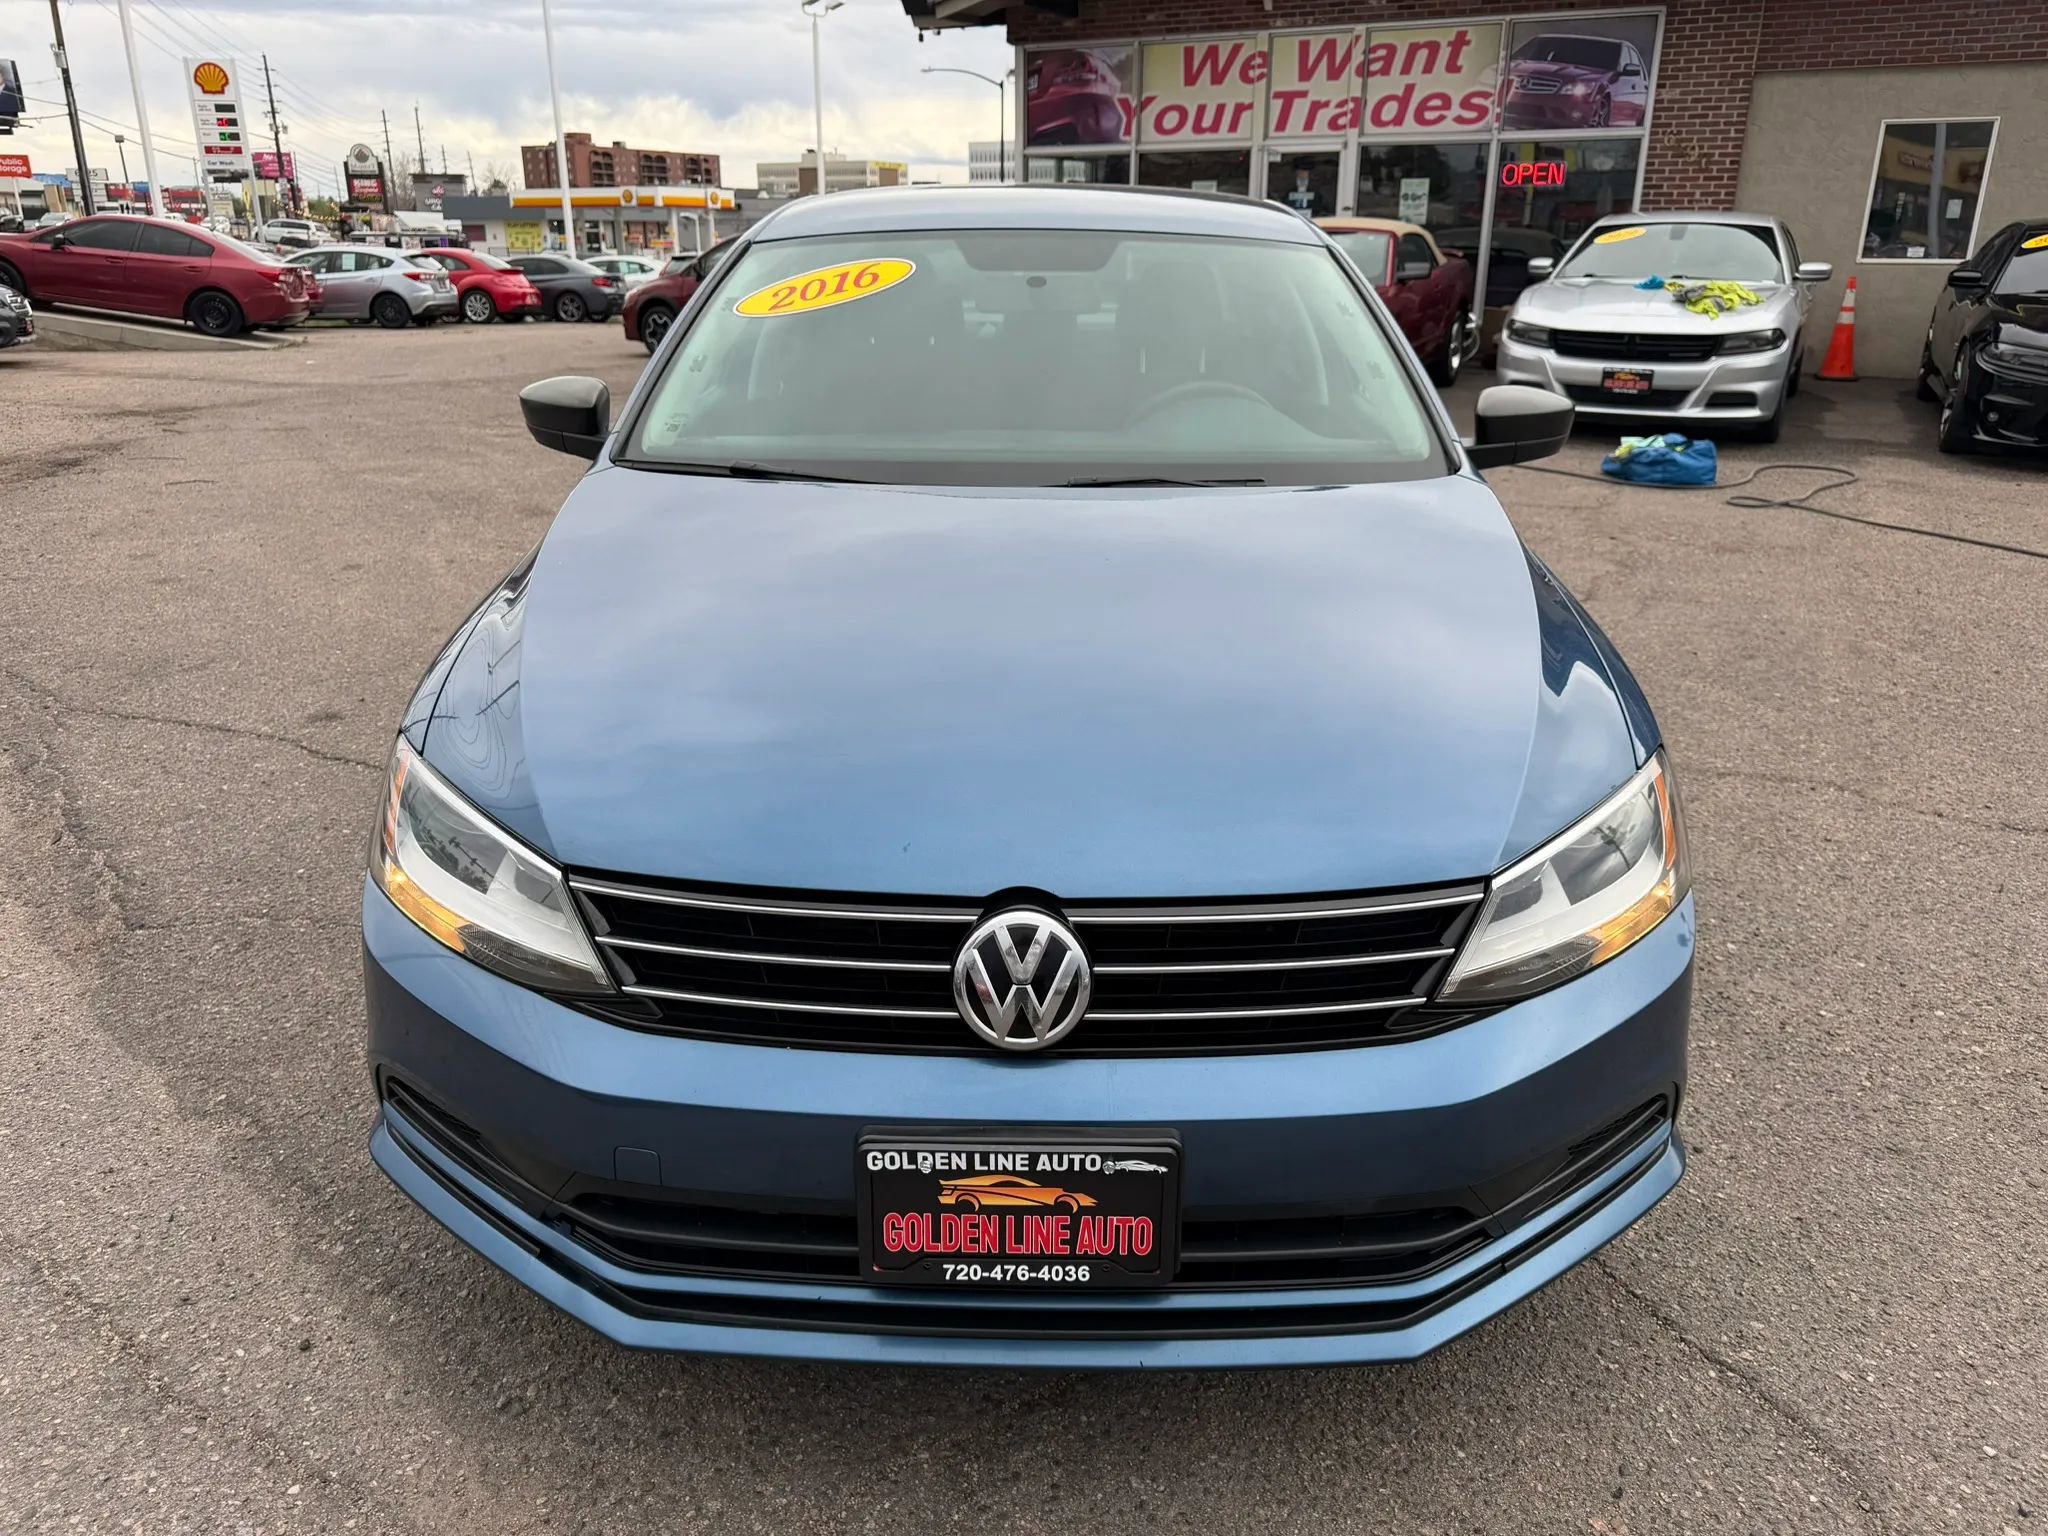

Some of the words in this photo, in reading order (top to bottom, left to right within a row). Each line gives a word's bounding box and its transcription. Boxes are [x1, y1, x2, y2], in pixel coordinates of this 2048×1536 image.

[1182, 43, 1268, 87] We
[1297, 30, 1471, 83] Want
[1117, 94, 1254, 138] Your
[1502, 162, 1566, 186] OPEN
[768, 262, 881, 311] 2016
[866, 1151, 967, 1173] GOLDEN
[974, 1153, 1030, 1172] LINE
[1036, 1153, 1102, 1172] AUTO
[883, 1212, 999, 1254] GOLDEN
[1005, 1215, 1071, 1255] LINE
[1076, 1216, 1153, 1256] AUTO
[942, 1264, 1091, 1282] 720-476-4036
